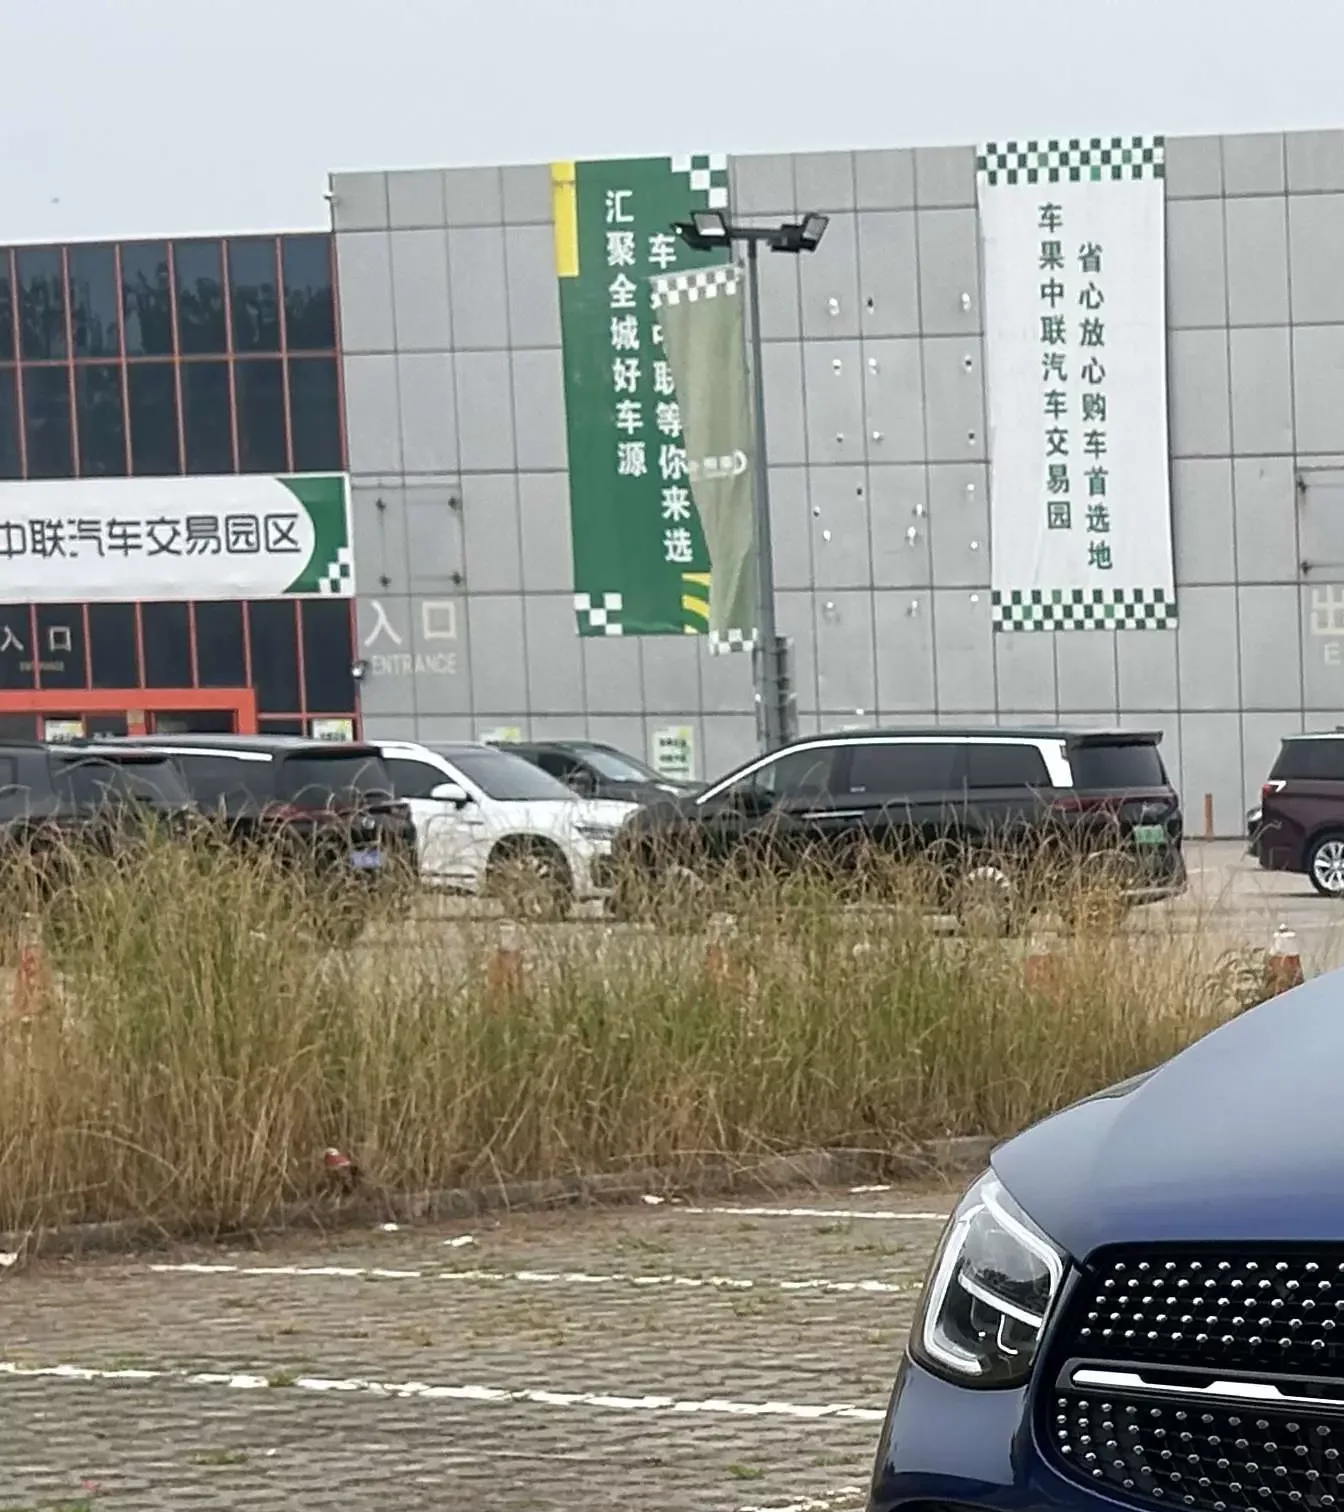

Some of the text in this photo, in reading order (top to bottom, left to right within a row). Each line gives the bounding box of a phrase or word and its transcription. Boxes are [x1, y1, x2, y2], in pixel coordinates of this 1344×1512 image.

[605, 189, 648, 477] 汇聚全城好车源
[647, 232, 693, 563] 车联等你来选
[1038, 201, 1072, 530] 车果中联汽车交易园
[1077, 241, 1114, 570] 省心放心购车首选地
[0, 513, 303, 560] 中联汽车交易园区
[0, 625, 72, 652] 入口
[364, 600, 457, 648] 入口
